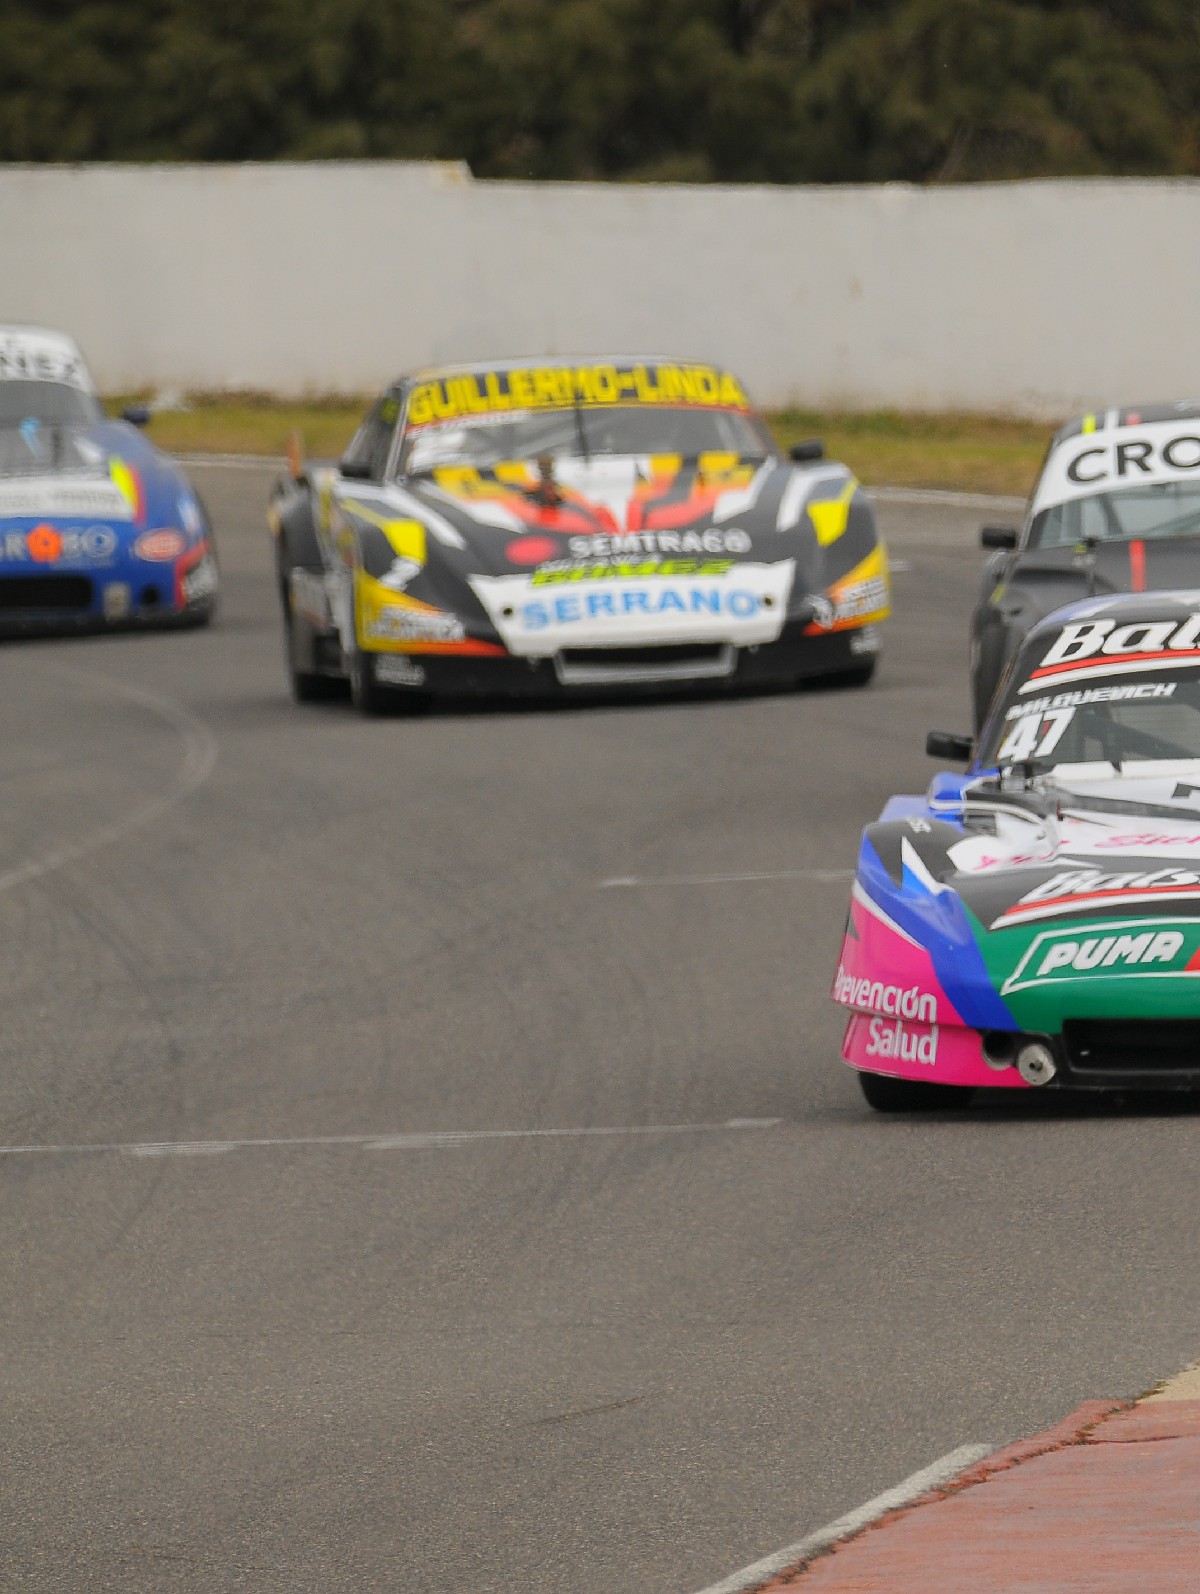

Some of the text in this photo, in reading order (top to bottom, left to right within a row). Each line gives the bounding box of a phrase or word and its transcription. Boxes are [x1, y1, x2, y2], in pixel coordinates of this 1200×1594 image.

[522, 588, 760, 629] SERRANO
[997, 706, 1077, 762] 47
[1036, 931, 1185, 977] PUMA
[865, 1015, 939, 1066] Salud
